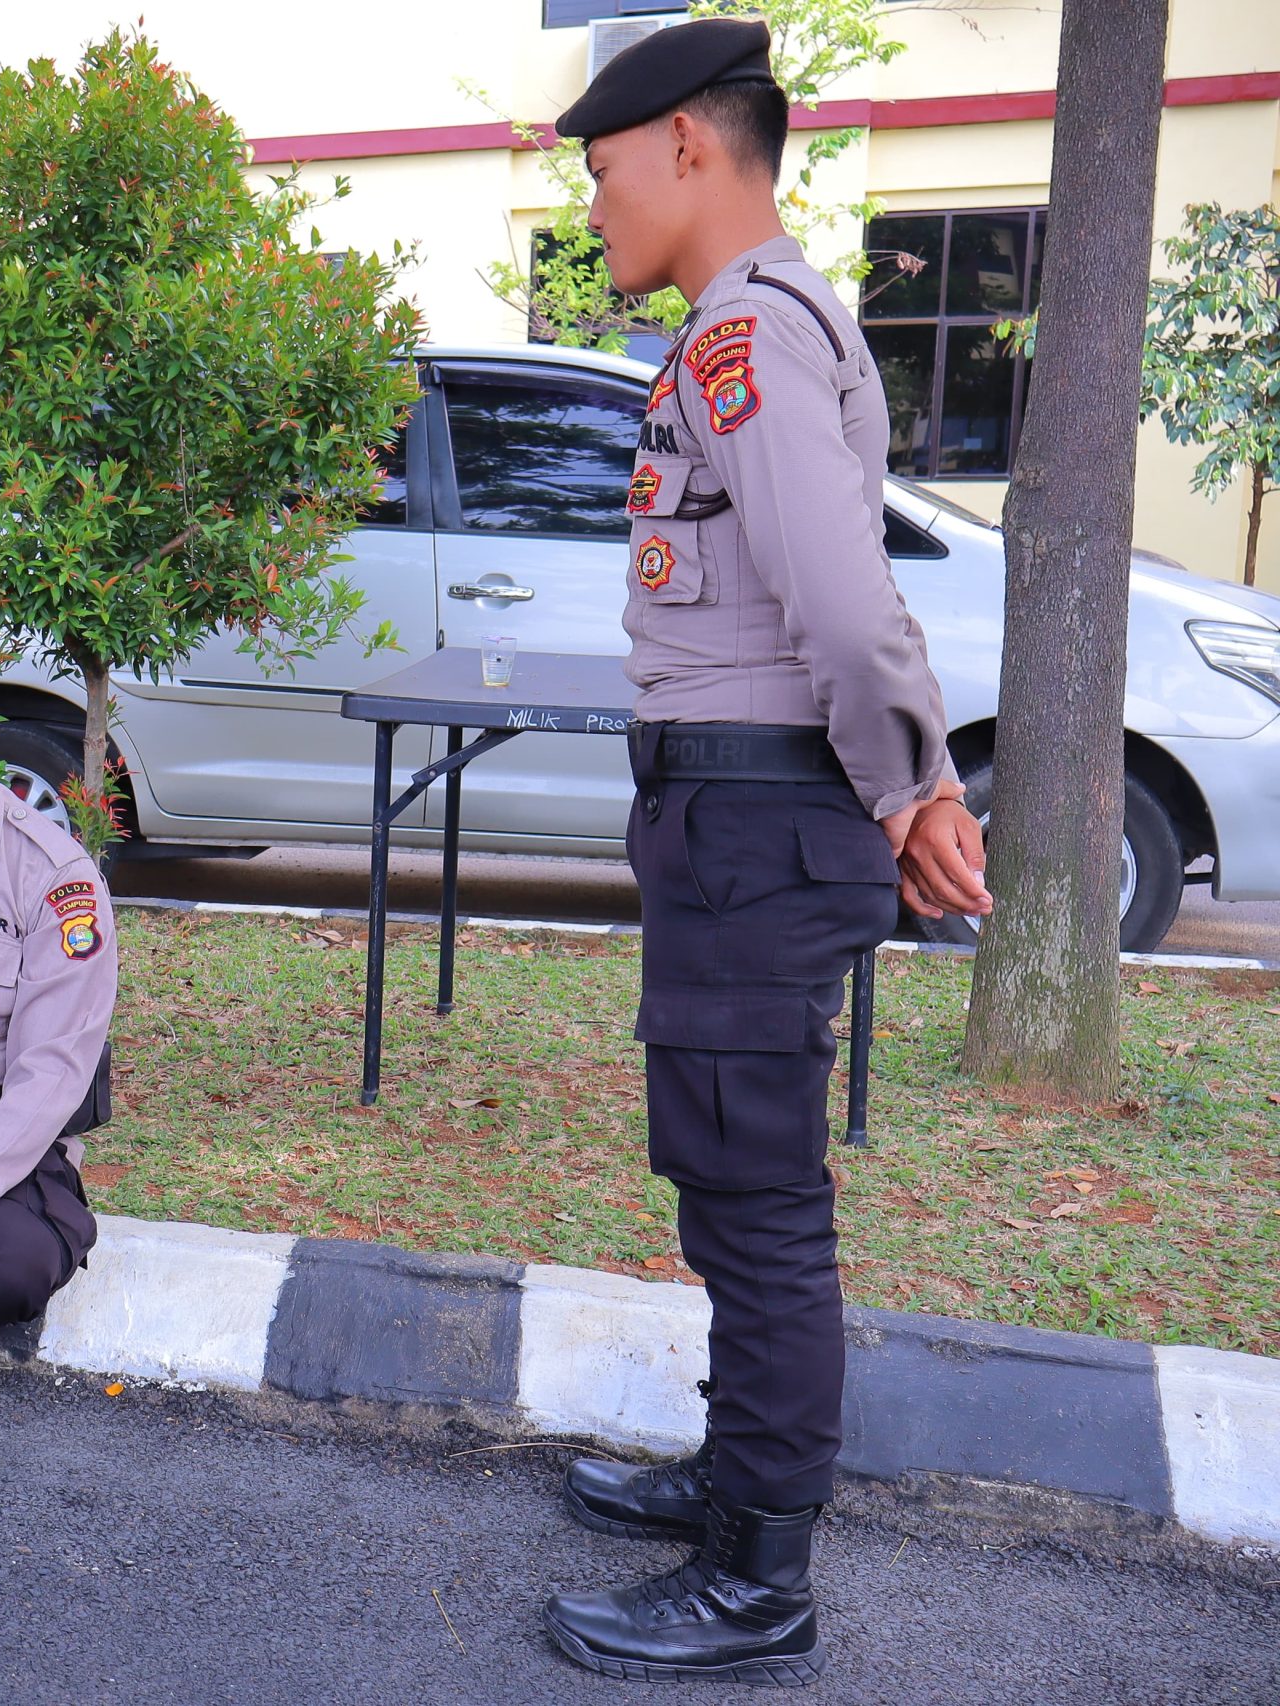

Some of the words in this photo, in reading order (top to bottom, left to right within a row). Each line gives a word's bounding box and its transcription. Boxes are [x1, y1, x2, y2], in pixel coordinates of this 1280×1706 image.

[690, 321, 748, 364] POLDA
[699, 346, 746, 377] LAMPUNG
[637, 420, 679, 454] OLRI
[506, 708, 560, 730] MILIK
[664, 738, 751, 767] POLRI
[50, 884, 89, 902] POLDA
[57, 900, 94, 914] LAMPUNG
